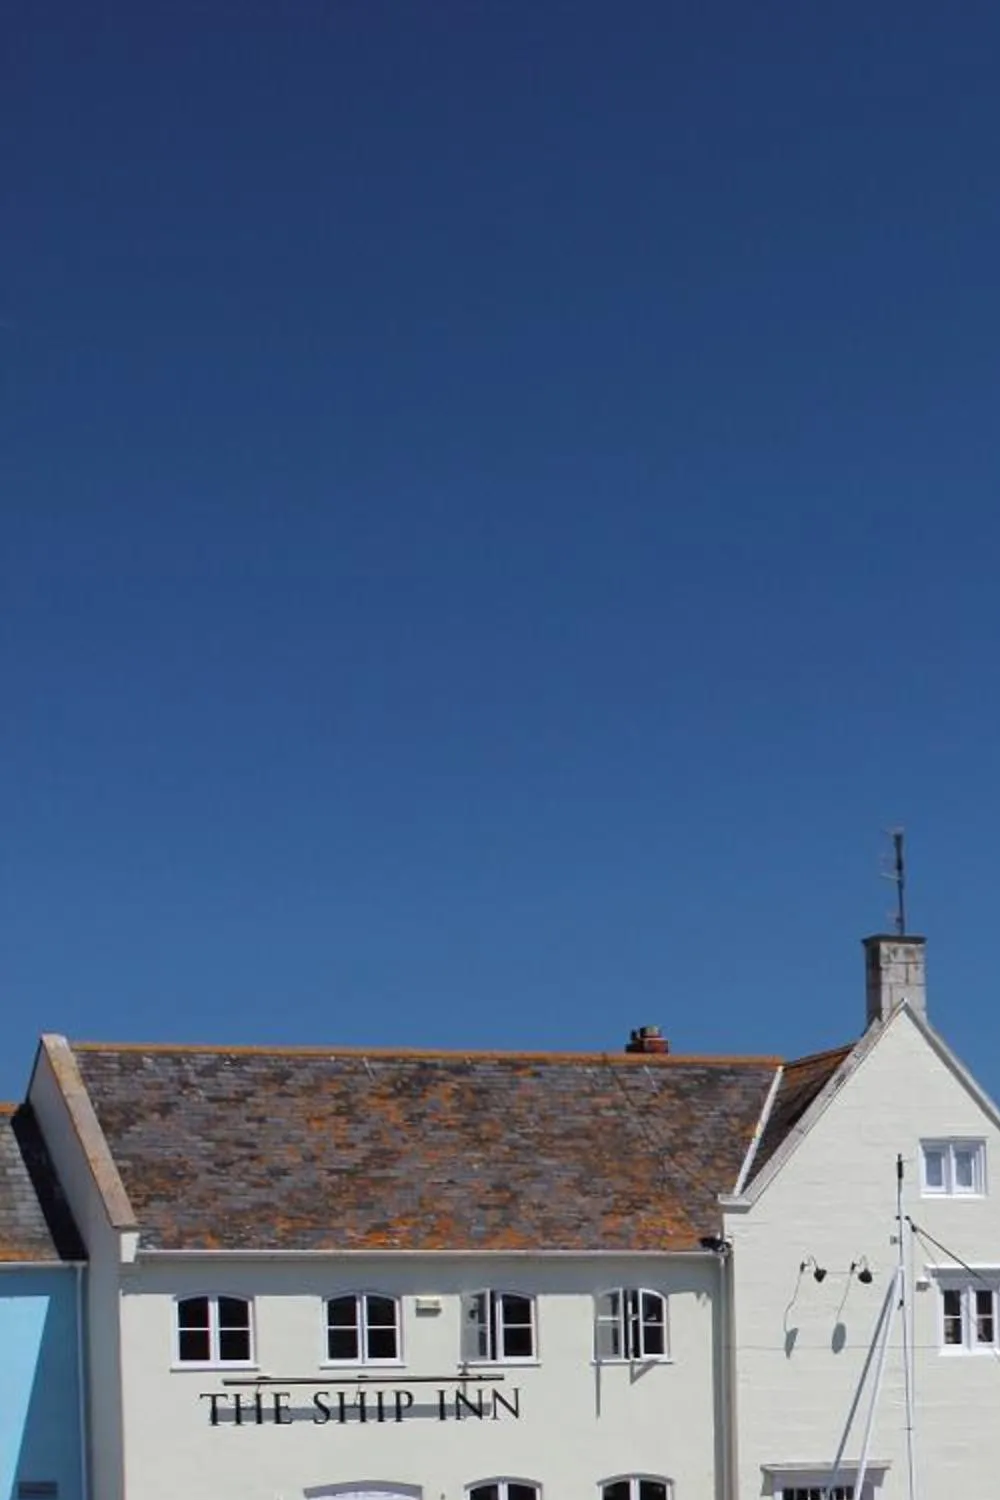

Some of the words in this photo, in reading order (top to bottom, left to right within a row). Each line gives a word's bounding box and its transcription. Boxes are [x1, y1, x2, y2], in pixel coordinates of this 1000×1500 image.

[201, 1392, 293, 1426] THE
[313, 1390, 413, 1425] SHIP
[436, 1387, 520, 1421] INN
